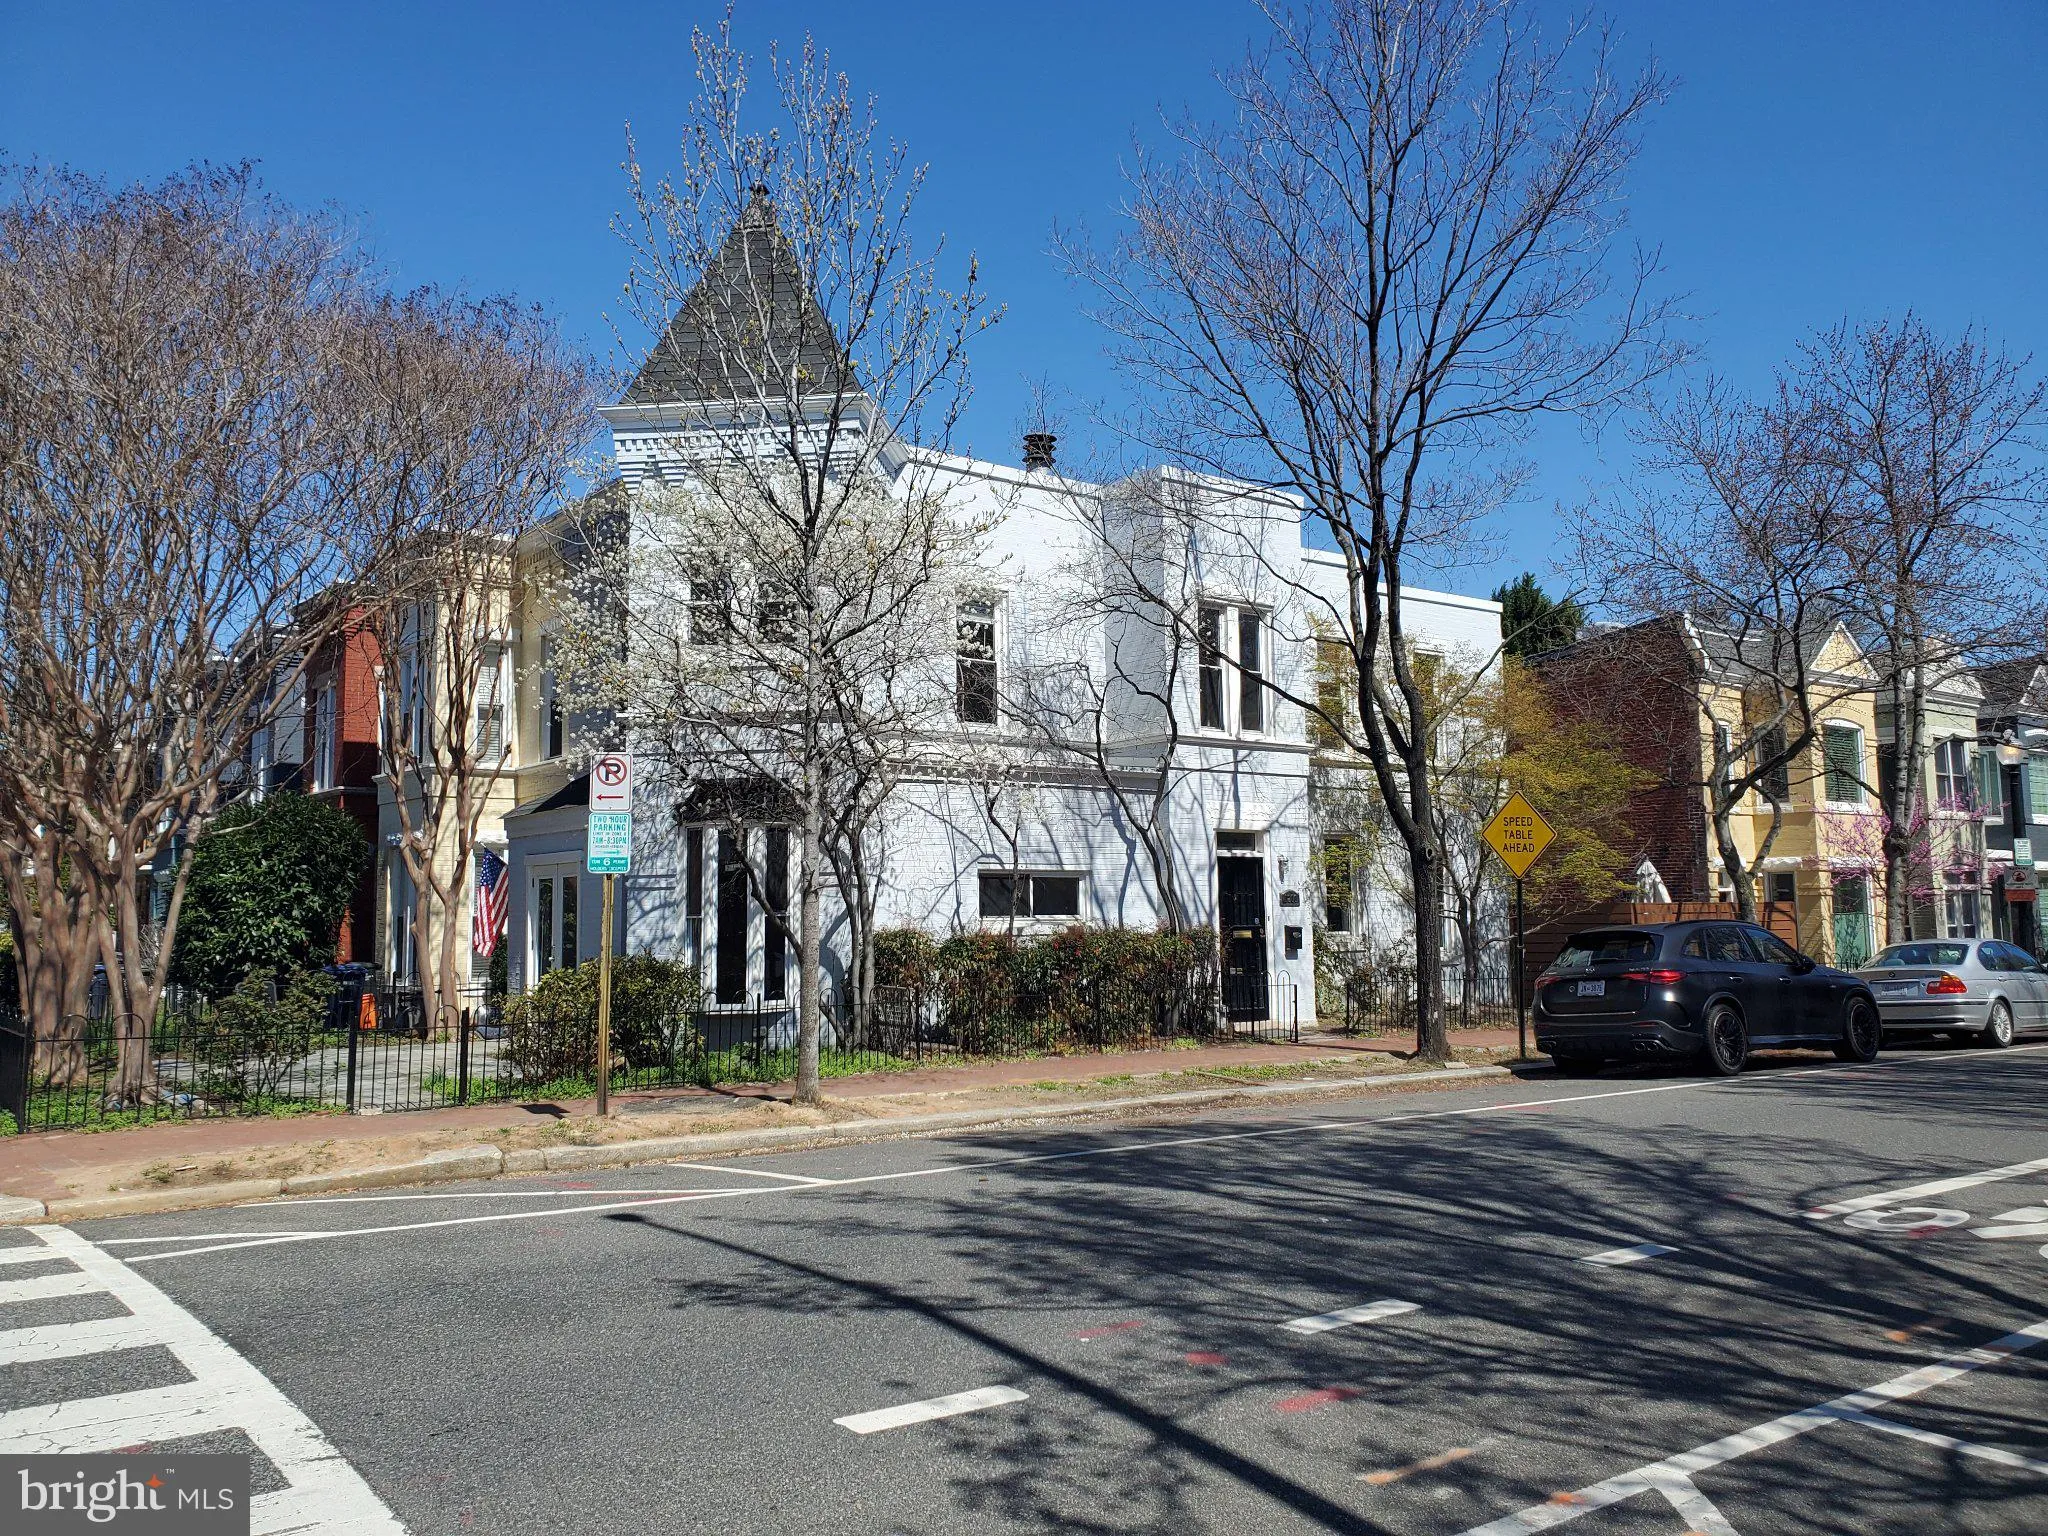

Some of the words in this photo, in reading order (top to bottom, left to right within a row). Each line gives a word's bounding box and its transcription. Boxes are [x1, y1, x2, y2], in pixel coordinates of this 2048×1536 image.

[610, 815, 627, 823] HOUR
[1503, 816, 1533, 827] SPEED
[593, 823, 626, 831] PARKING
[1503, 829, 1533, 840] TABLE
[1502, 842, 1535, 853] AHEAD
[603, 857, 610, 866] 6
